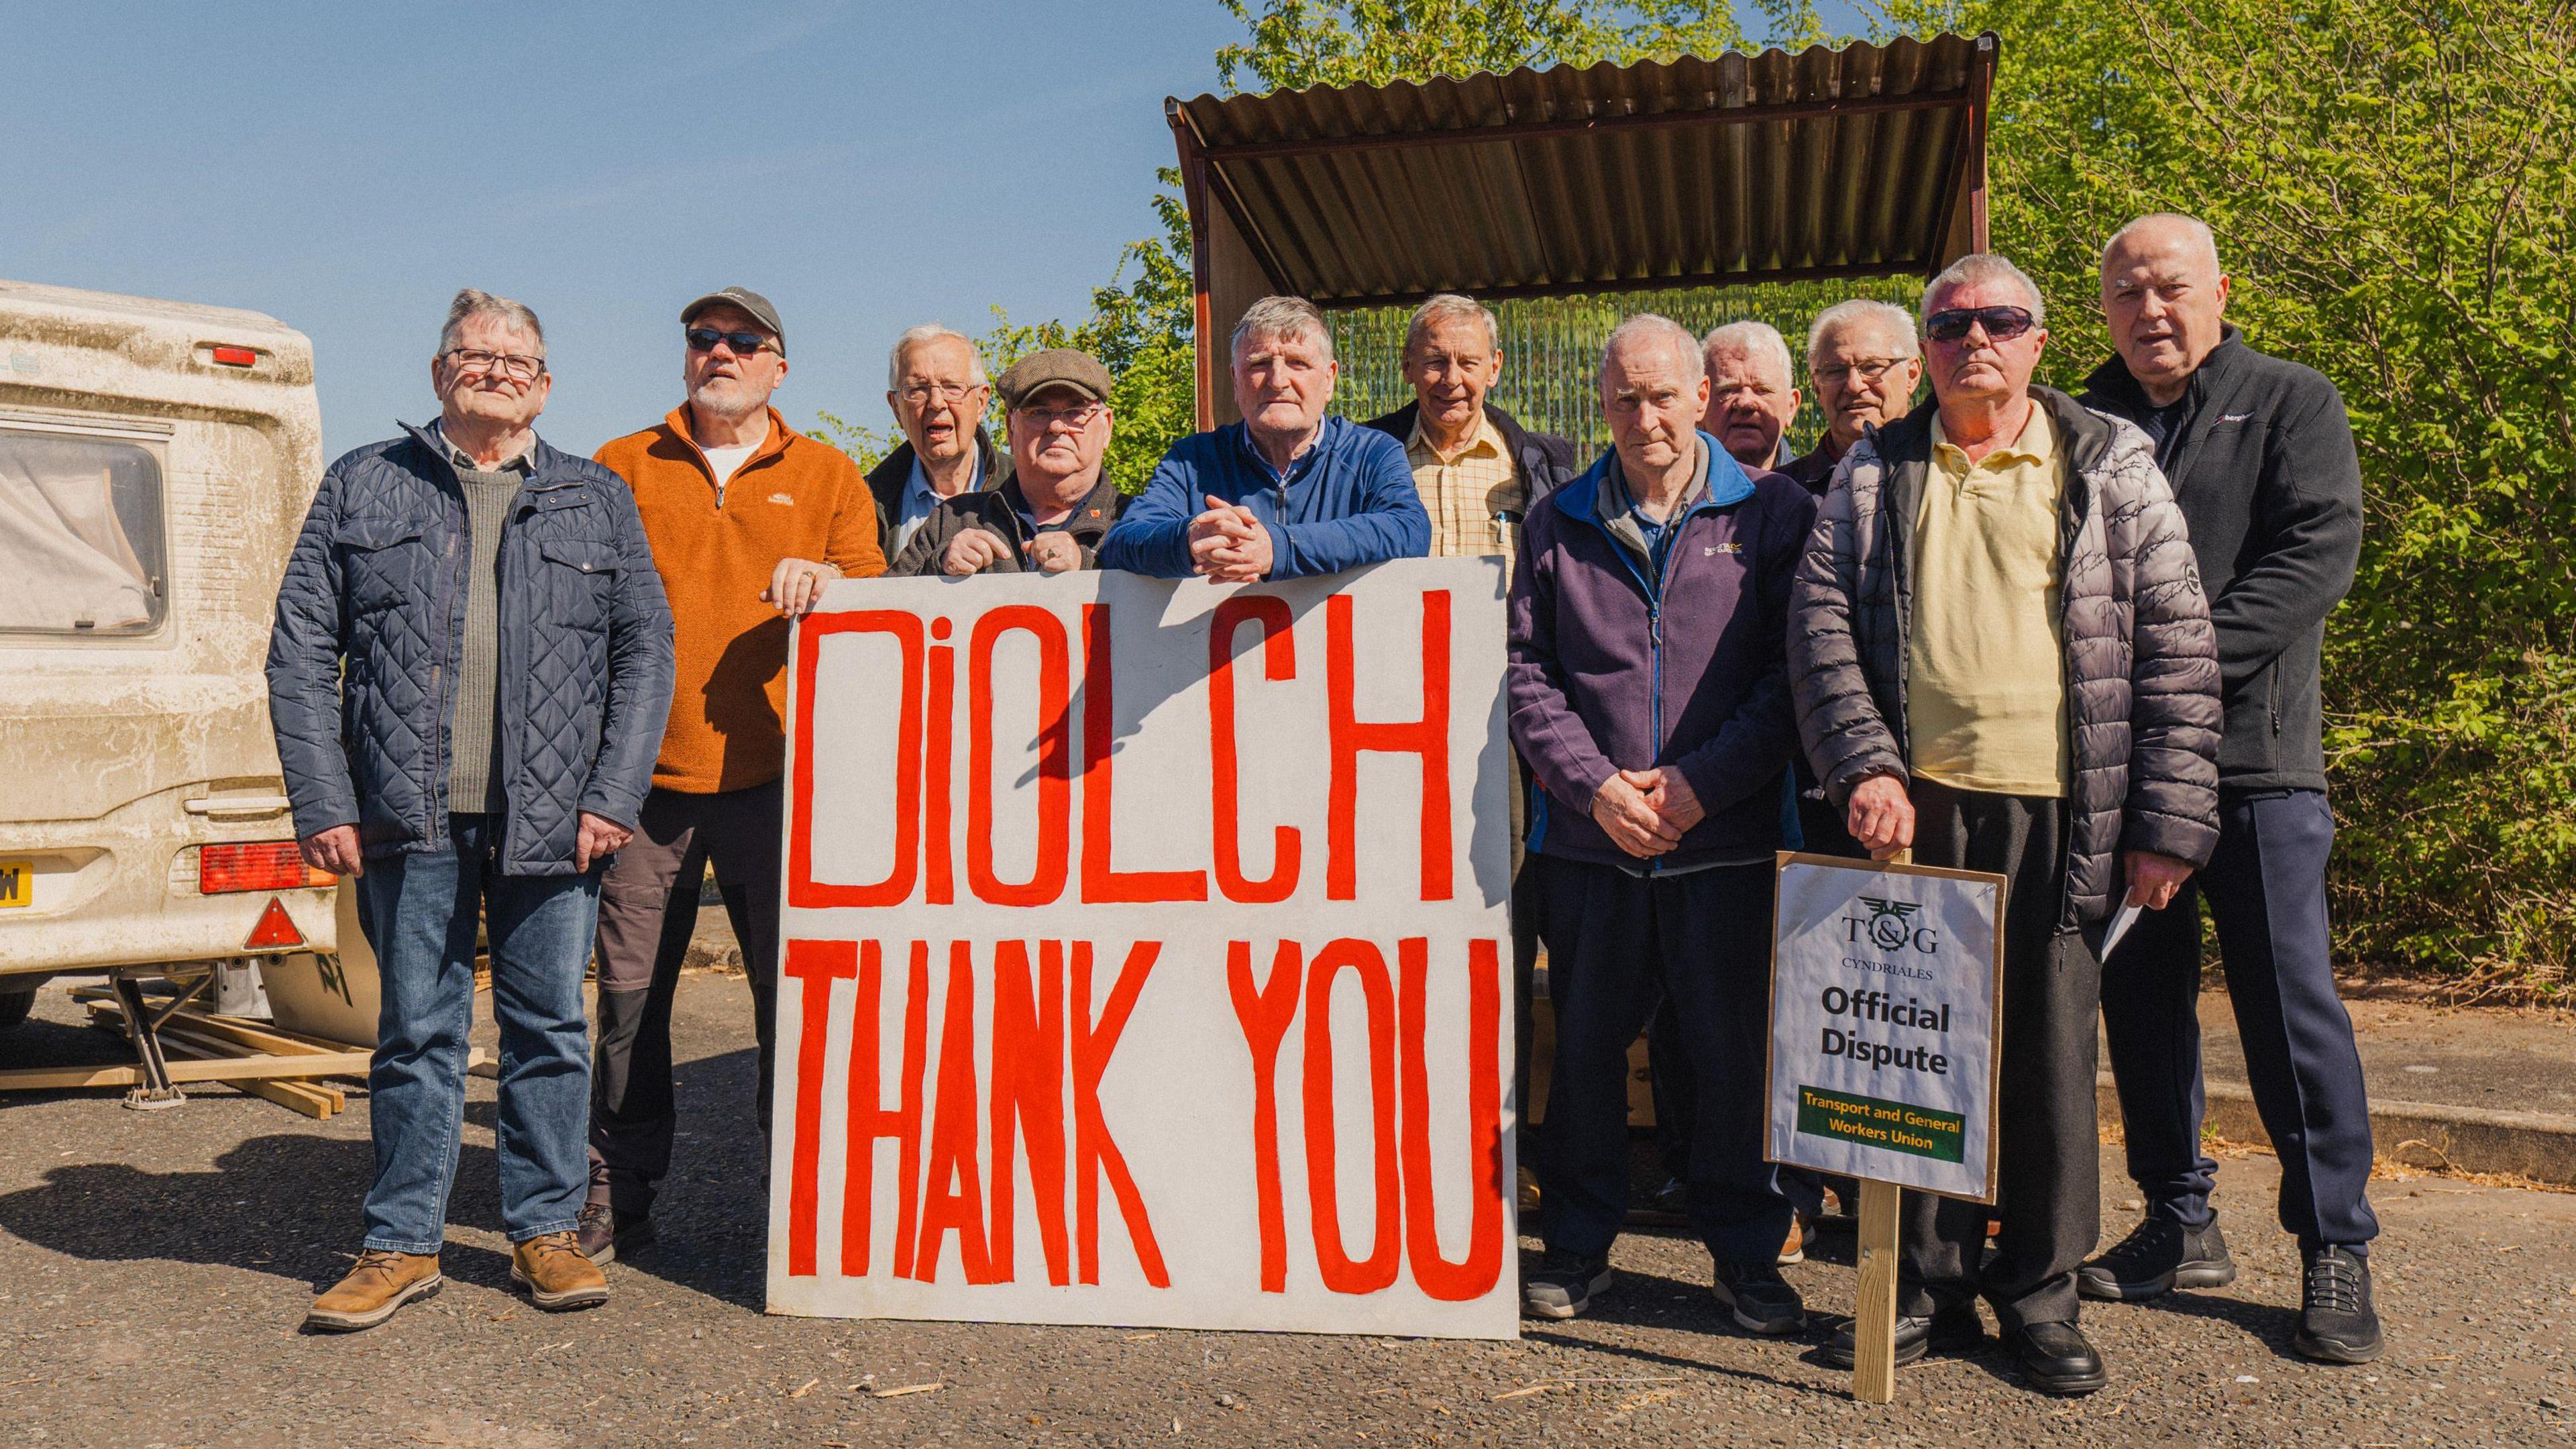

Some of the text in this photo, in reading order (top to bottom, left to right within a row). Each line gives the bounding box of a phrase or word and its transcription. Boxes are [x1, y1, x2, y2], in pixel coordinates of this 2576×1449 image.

[1842, 957, 1933, 980] CYNDRIALES
[1821, 987, 1949, 1032] Official
[1821, 1028, 1948, 1075] Dispute
[784, 936, 1503, 1301] THANK YOU
[1805, 1092, 1960, 1134] Transport and General
[1829, 1118, 1933, 1149] Workers Union
